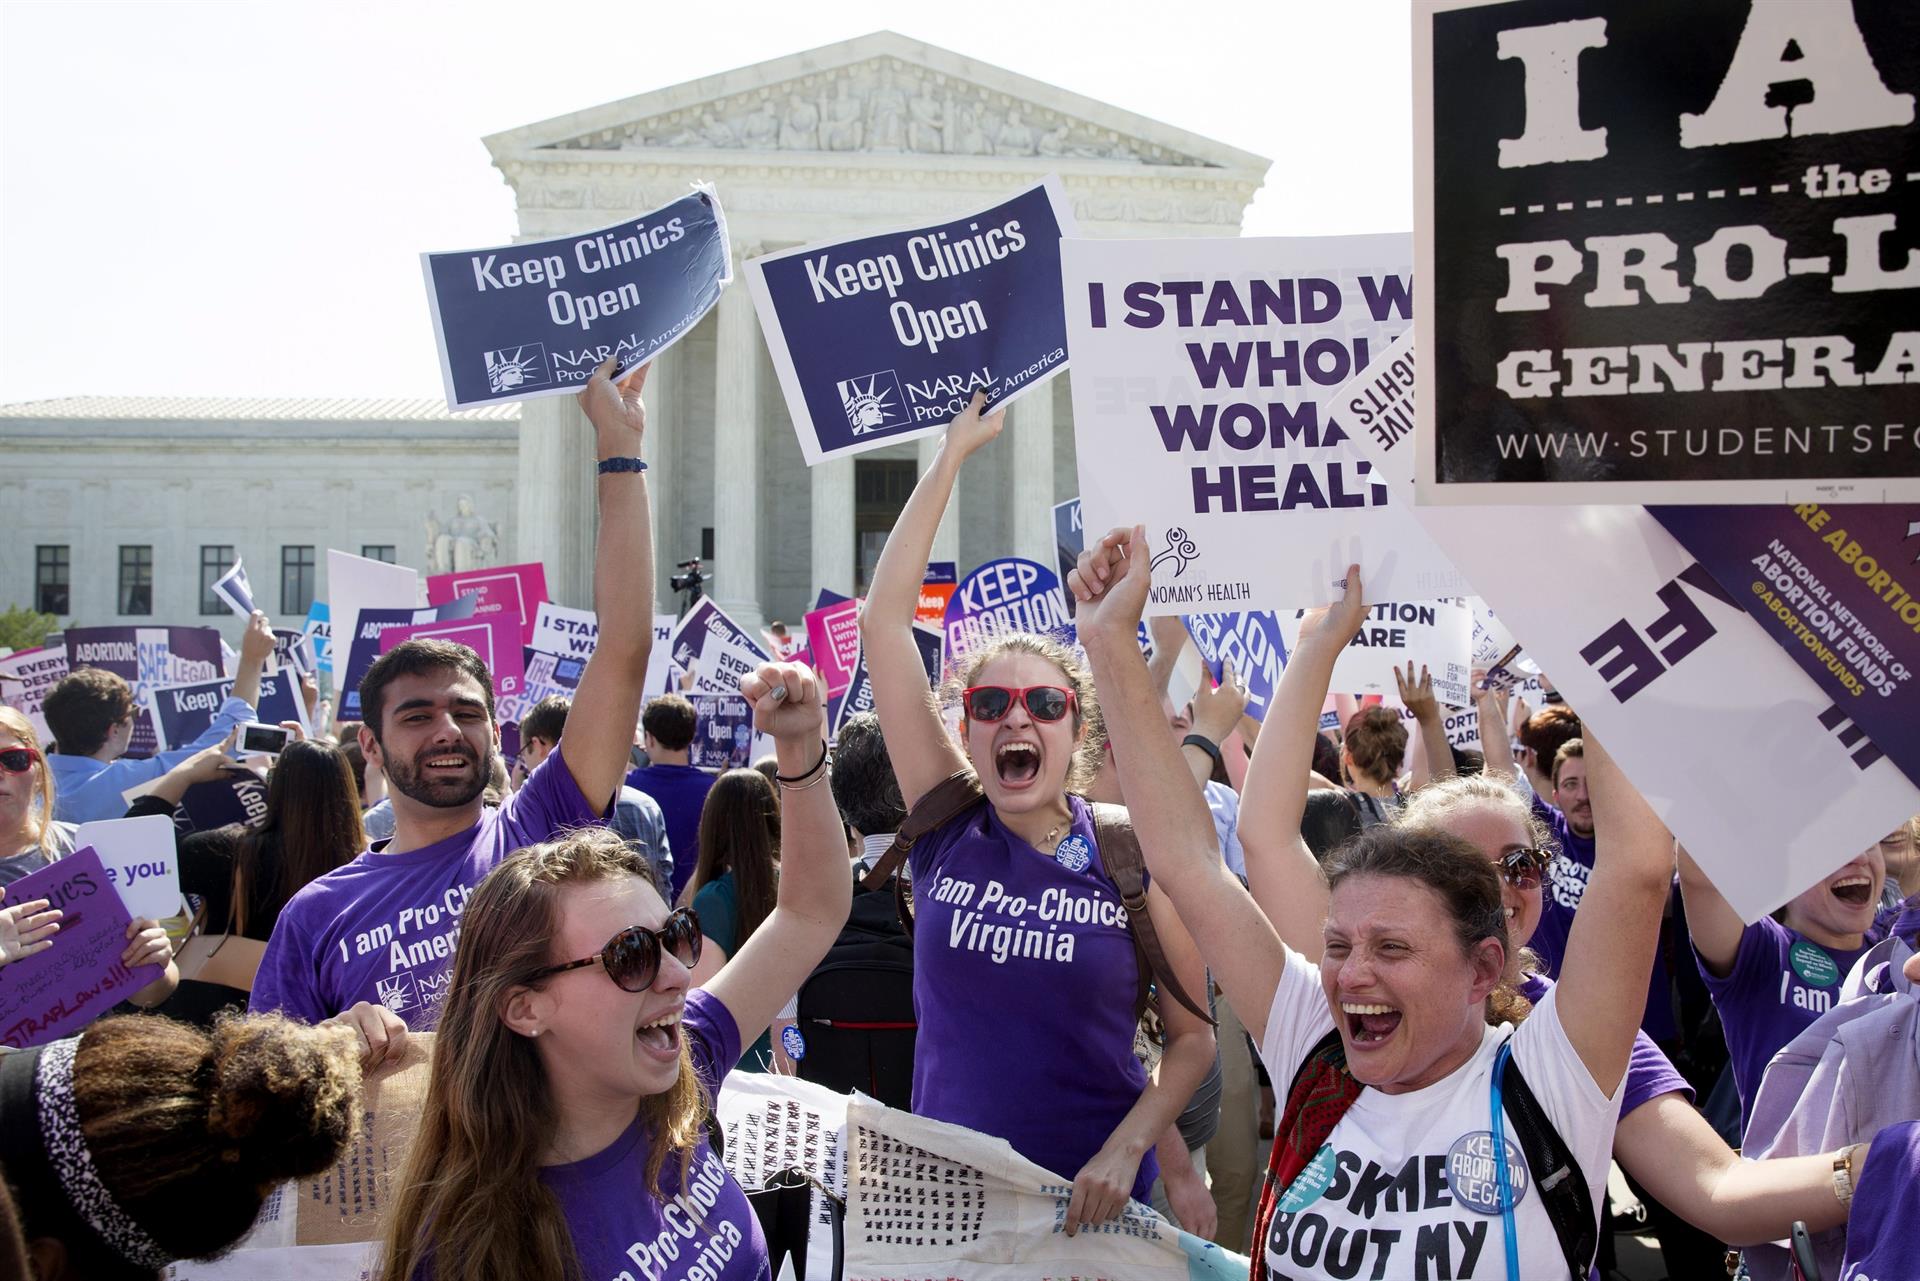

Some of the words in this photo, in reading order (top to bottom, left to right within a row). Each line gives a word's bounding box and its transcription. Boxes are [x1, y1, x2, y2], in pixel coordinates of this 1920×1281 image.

[1496, 17, 1608, 168] I
[1801, 163, 1892, 200] the
[471, 254, 566, 292] Keep
[574, 216, 685, 274] Clinics
[803, 253, 904, 303] Keep
[906, 219, 1027, 282] Clinics
[547, 282, 641, 330] Open
[889, 298, 988, 354] Open
[1088, 282, 1107, 328] I
[1123, 277, 1342, 329] STAND
[551, 334, 645, 369] NARAL
[555, 347, 646, 383] Pro-Coice
[904, 366, 1000, 403] NARAL
[912, 384, 1001, 422] Pro-Chce
[1003, 346, 1065, 393] America
[960, 562, 1038, 614] KEEP
[1206, 581, 1251, 600] HEALTH
[1822, 528, 1920, 634] ABORTIO
[543, 615, 549, 628] I
[1751, 553, 1843, 643] ABORTION
[1836, 636, 1897, 697] FUNDS
[1768, 538, 1833, 605] NATIONAL
[1829, 601, 1895, 666] NETWORK
[1890, 661, 1912, 682] OF
[76, 642, 137, 662] ABORTION:
[1751, 580, 1865, 697] @ABORTIONFUNDS
[1430, 677, 1468, 694] EPRODUCTIVE
[1446, 671, 1459, 682] FOR
[173, 689, 219, 713] Keep
[693, 697, 716, 720] Keep
[717, 695, 747, 717] Clinics
[708, 720, 732, 744] Open
[232, 779, 270, 830] Keep
[124, 860, 171, 887] you.
[1057, 840, 1070, 863] KEEP
[935, 876, 976, 905] am
[977, 880, 1129, 929] Pro-Choice
[338, 938, 350, 963] I
[355, 923, 393, 956] am
[949, 908, 1075, 964] Virginia
[1780, 970, 1790, 1004] I
[1793, 985, 1831, 1013] am
[626, 1151, 726, 1281] Pro-Choice
[1414, 1220, 1488, 1281] MY
